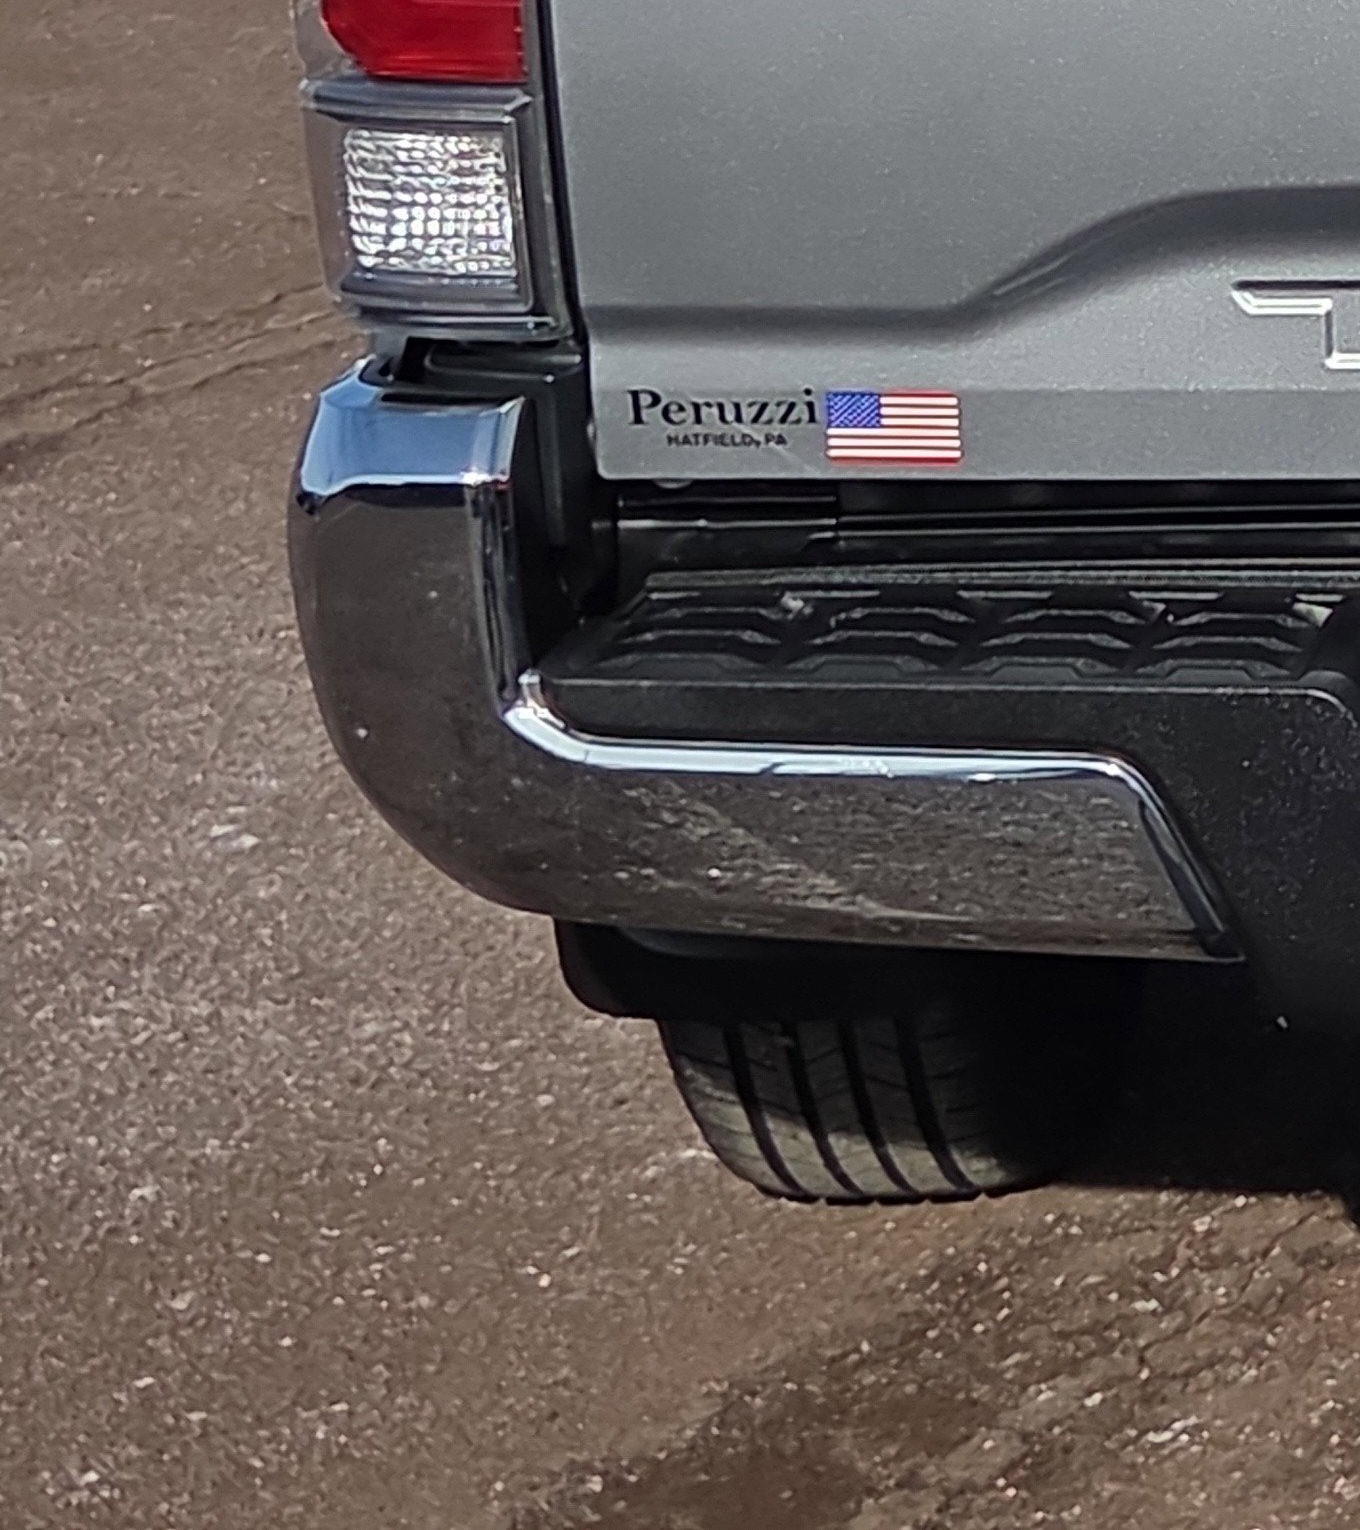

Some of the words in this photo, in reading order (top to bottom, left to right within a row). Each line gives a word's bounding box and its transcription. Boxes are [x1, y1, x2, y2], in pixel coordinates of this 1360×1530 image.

[627, 387, 818, 426] Peruzzi
[667, 433, 761, 447] HATFIELD,
[764, 433, 788, 446] PA
